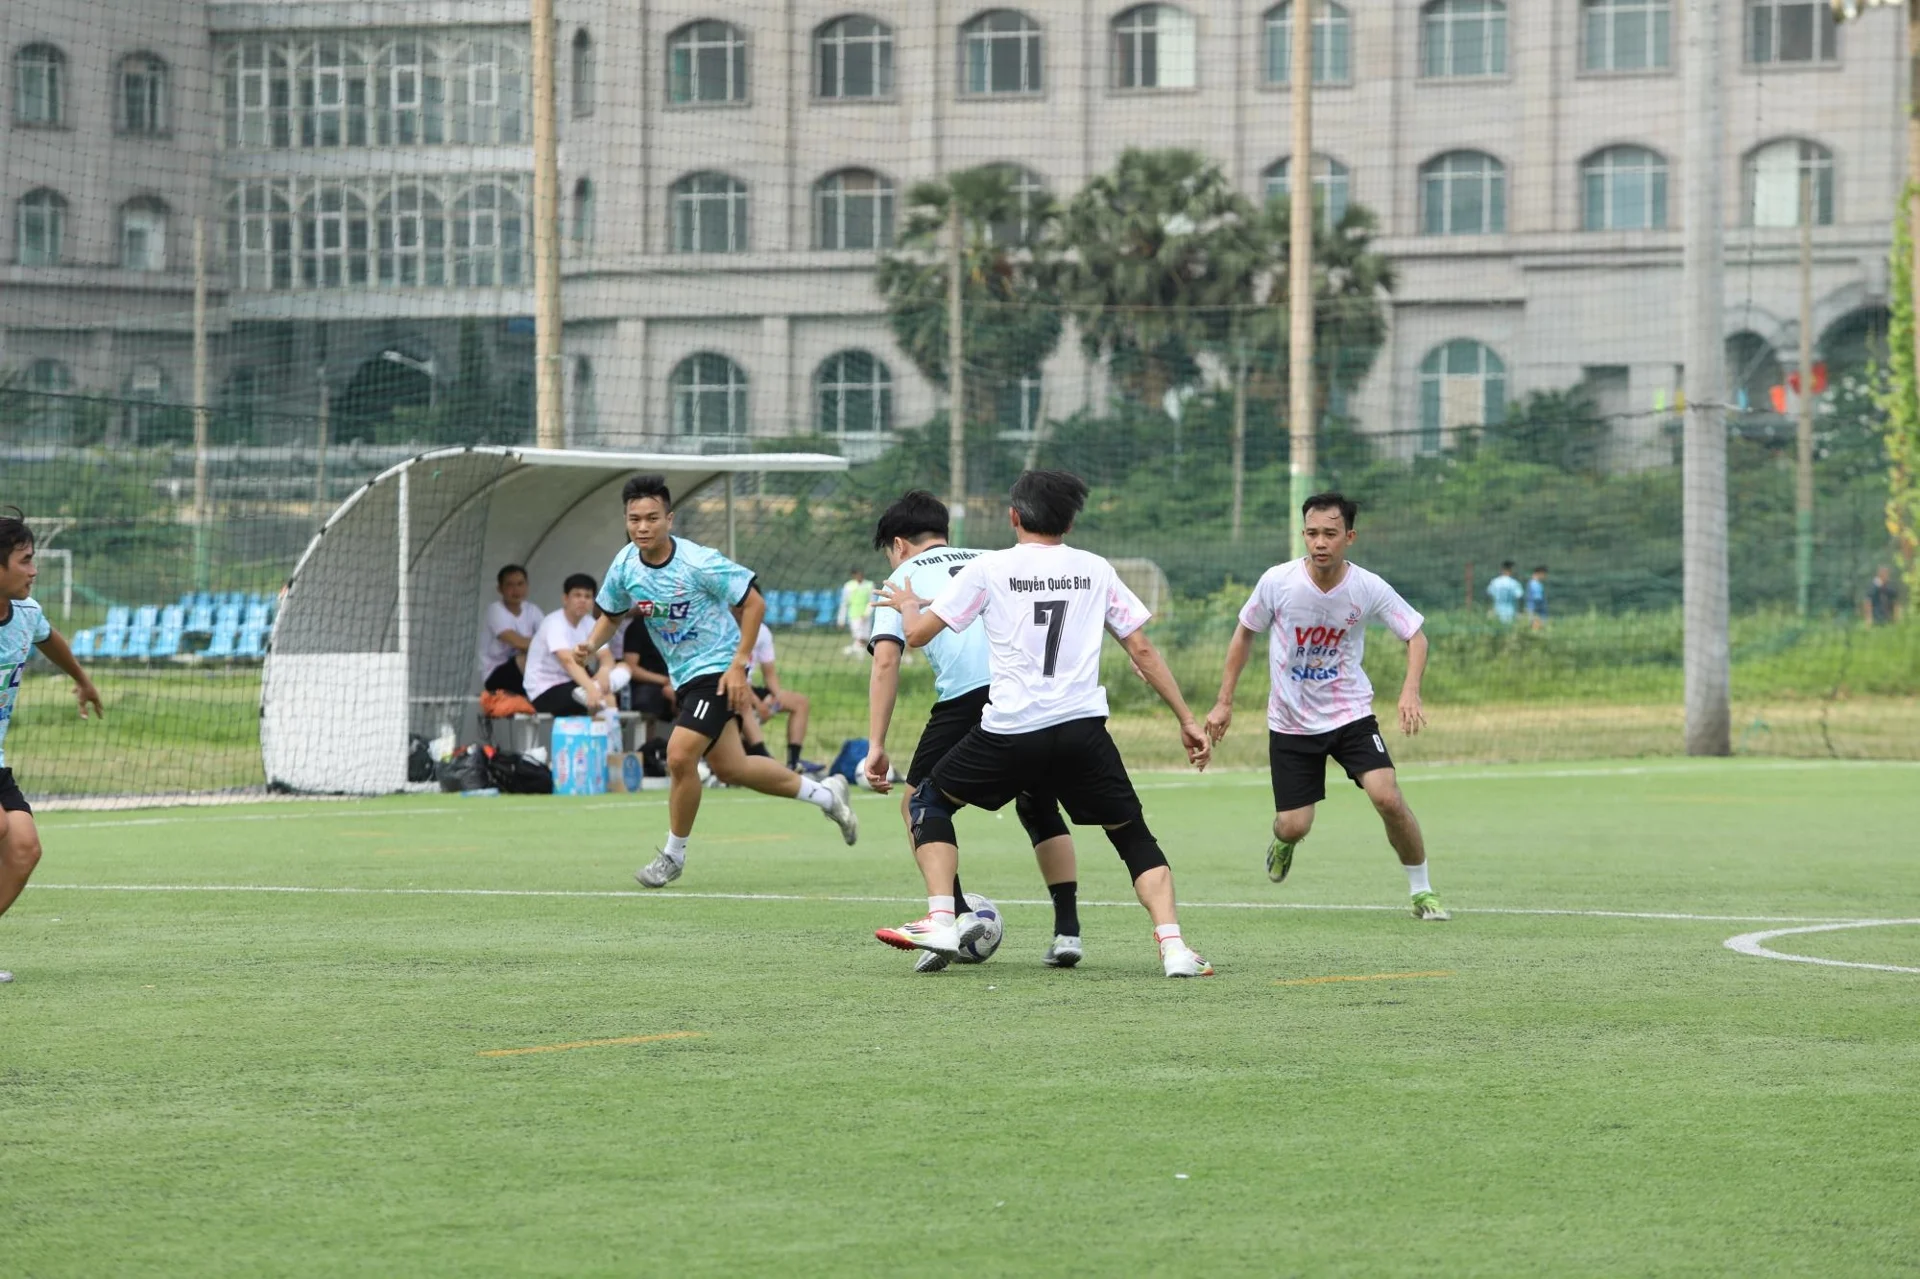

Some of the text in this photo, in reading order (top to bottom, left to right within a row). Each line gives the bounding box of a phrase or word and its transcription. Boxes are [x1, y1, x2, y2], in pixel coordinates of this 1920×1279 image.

[1009, 575, 1046, 593] Nguyễn
[1047, 574, 1072, 592] Quốc
[1034, 600, 1069, 678] 7
[1295, 625, 1346, 647] VOH
[693, 699, 710, 720] 11
